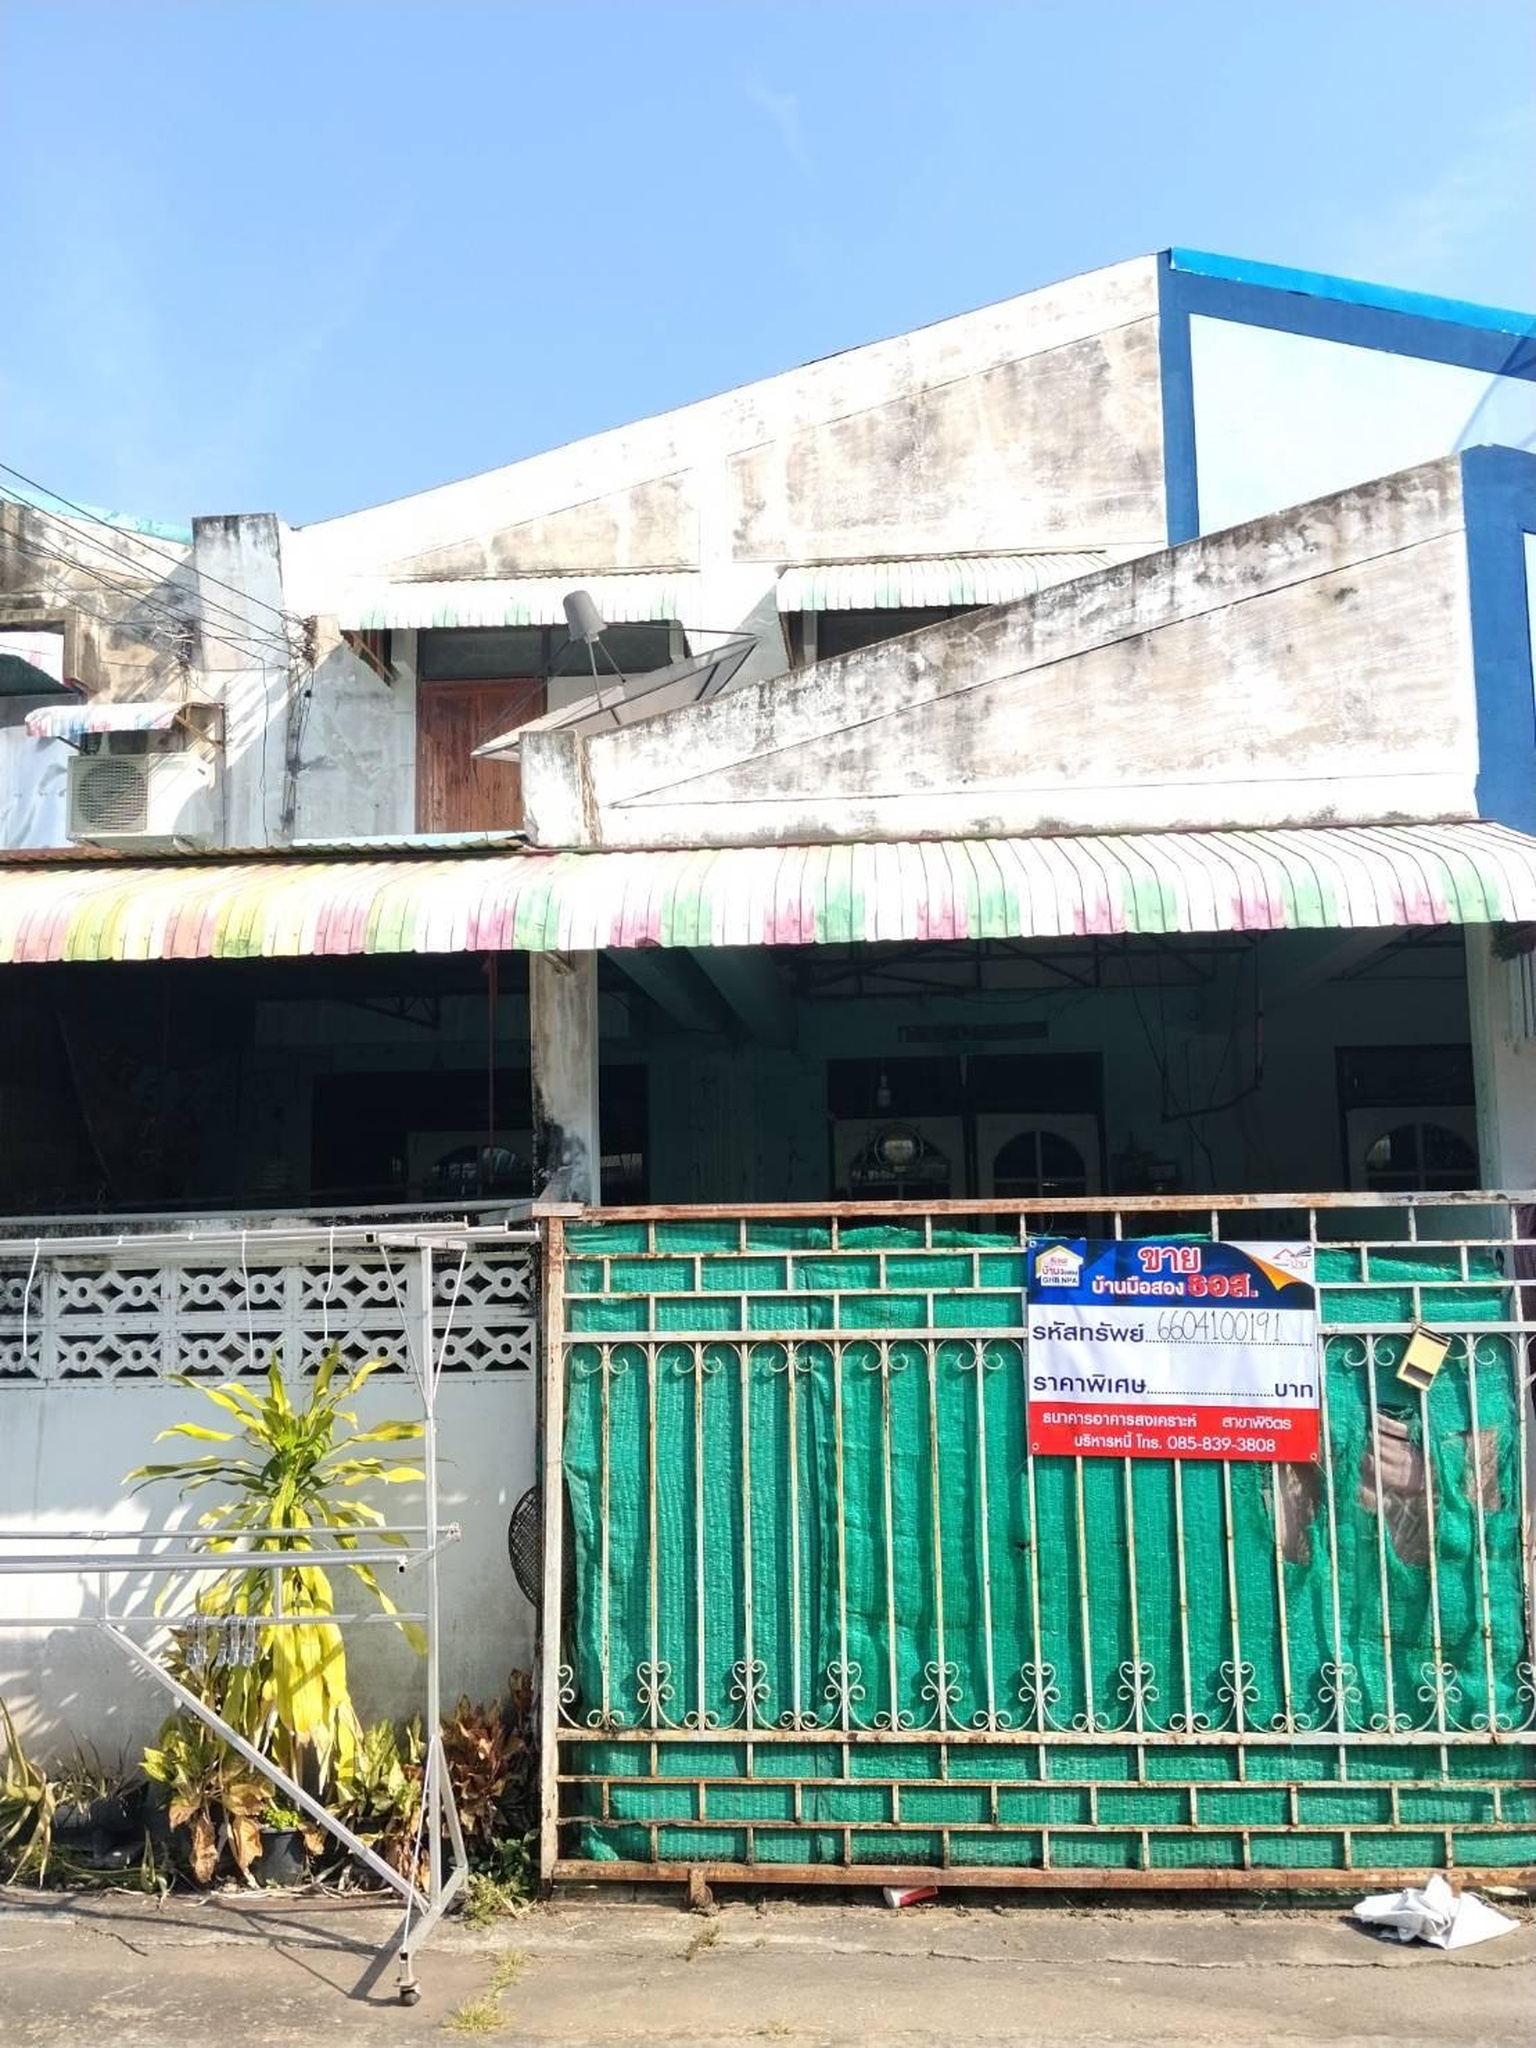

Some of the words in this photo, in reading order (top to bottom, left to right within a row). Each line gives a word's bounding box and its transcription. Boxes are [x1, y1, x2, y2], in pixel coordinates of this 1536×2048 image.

[1138, 1246, 1201, 1273] ขาย
[1092, 1275, 1184, 1296] บ้านมือสอง
[1187, 1272, 1259, 1298] ธอส.
[1032, 1321, 1145, 1343] รหัสทรัพย์
[1157, 1310, 1281, 1342] 6604100191
[1033, 1374, 1147, 1394] ราคาพิเศษ
[1274, 1382, 1314, 1398] บาท
[1042, 1412, 1197, 1428] ธนาคารอาคารสงเคราะห์
[1222, 1415, 1292, 1430] สาขาพิจิตร
[1074, 1431, 1132, 1448] บริหารหนี้
[1136, 1433, 1163, 1449] โทร.
[1167, 1435, 1276, 1452] 085-839-3808
